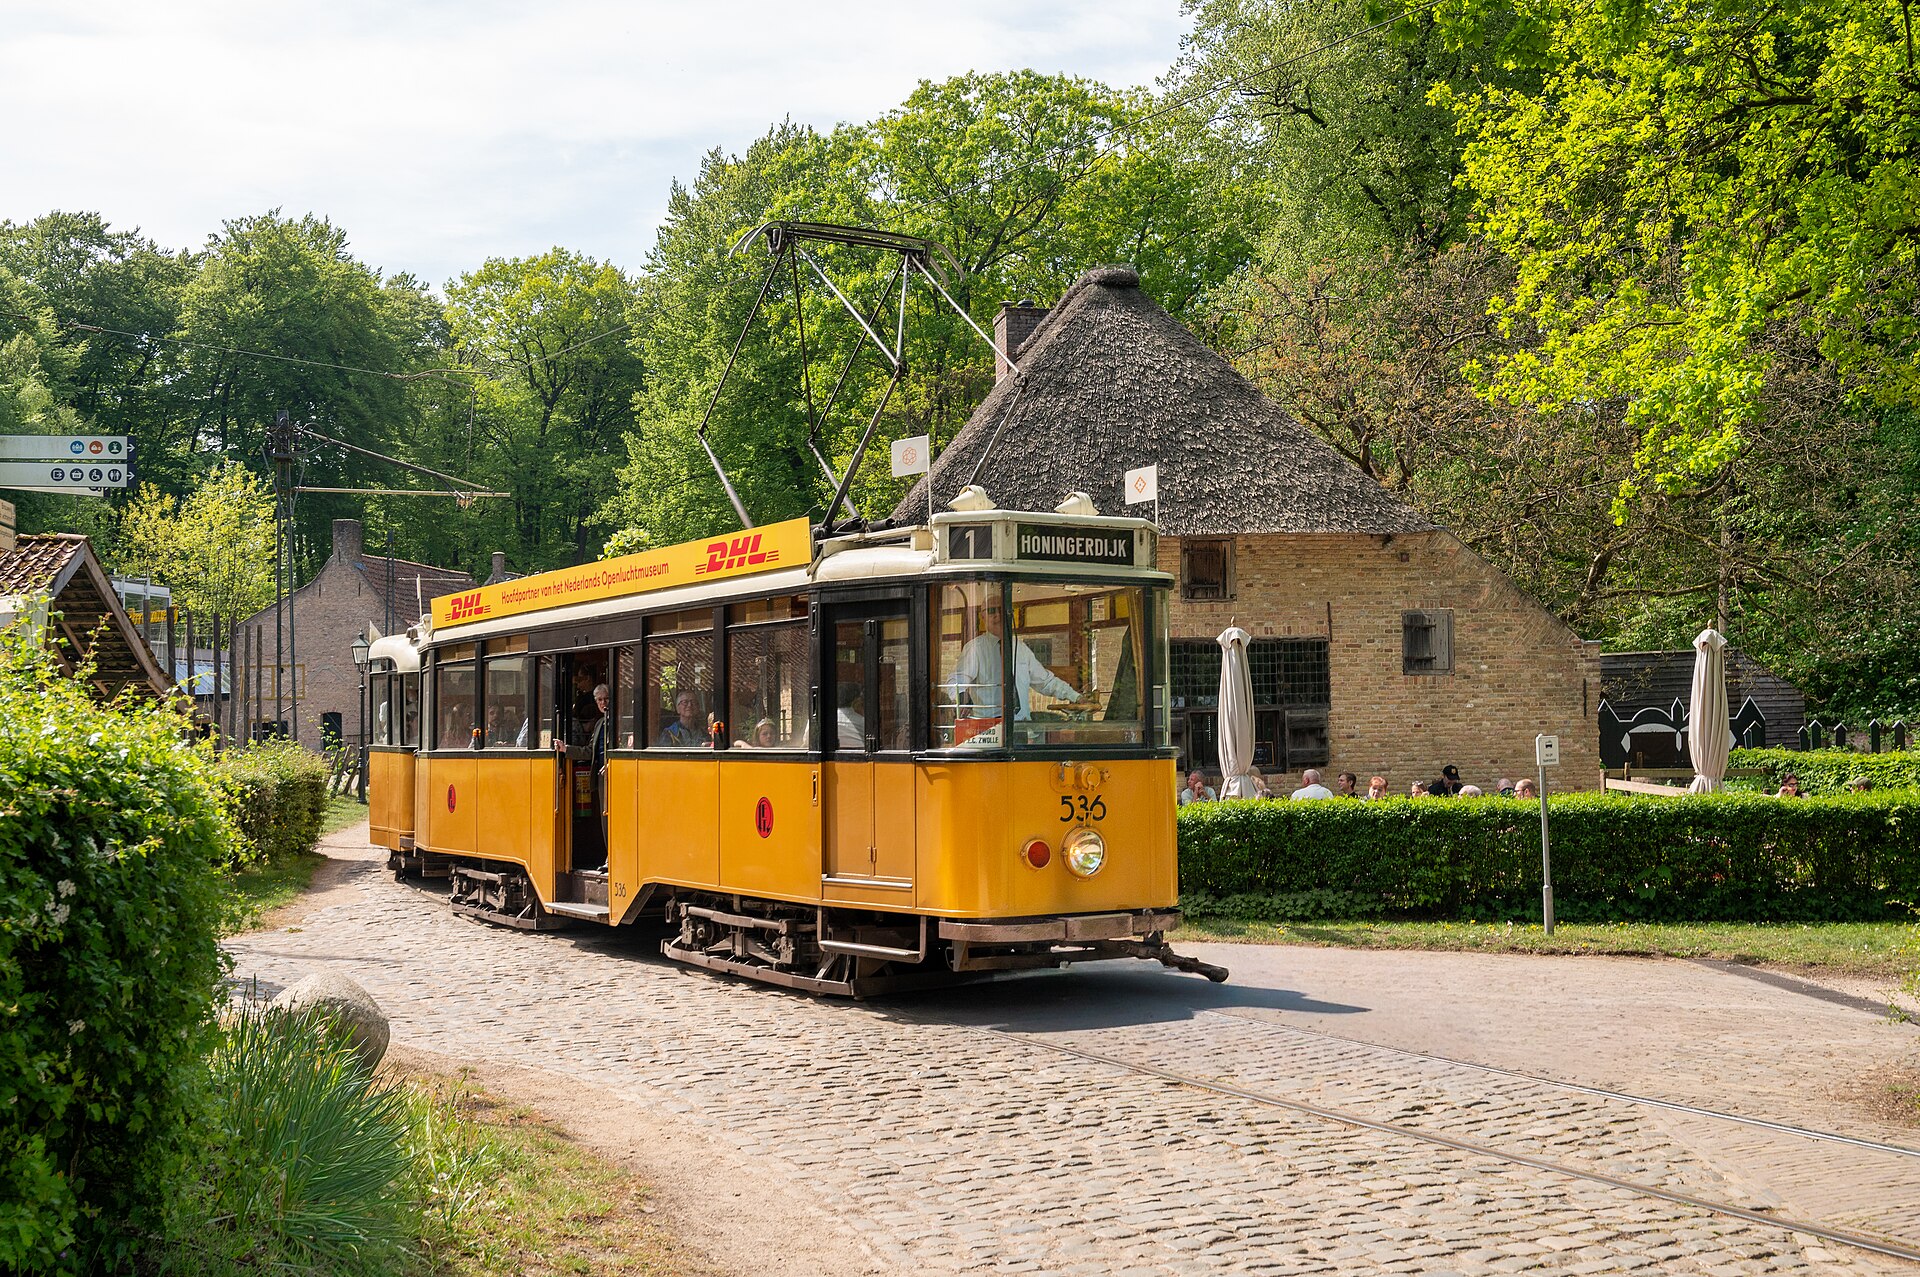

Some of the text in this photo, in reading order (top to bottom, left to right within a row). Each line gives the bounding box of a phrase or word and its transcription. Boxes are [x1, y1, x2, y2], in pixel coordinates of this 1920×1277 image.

[705, 534, 767, 573] DHL
[964, 529, 976, 559] 1
[1020, 534, 1127, 558] HONINGERDIJK
[501, 562, 669, 605] Hoofdpartner van het Nederlands Openluchtmuseum
[451, 592, 484, 620] DHL
[978, 736, 999, 744] ZWOLLE
[1060, 794, 1107, 824] 536
[614, 882, 627, 898] 536
